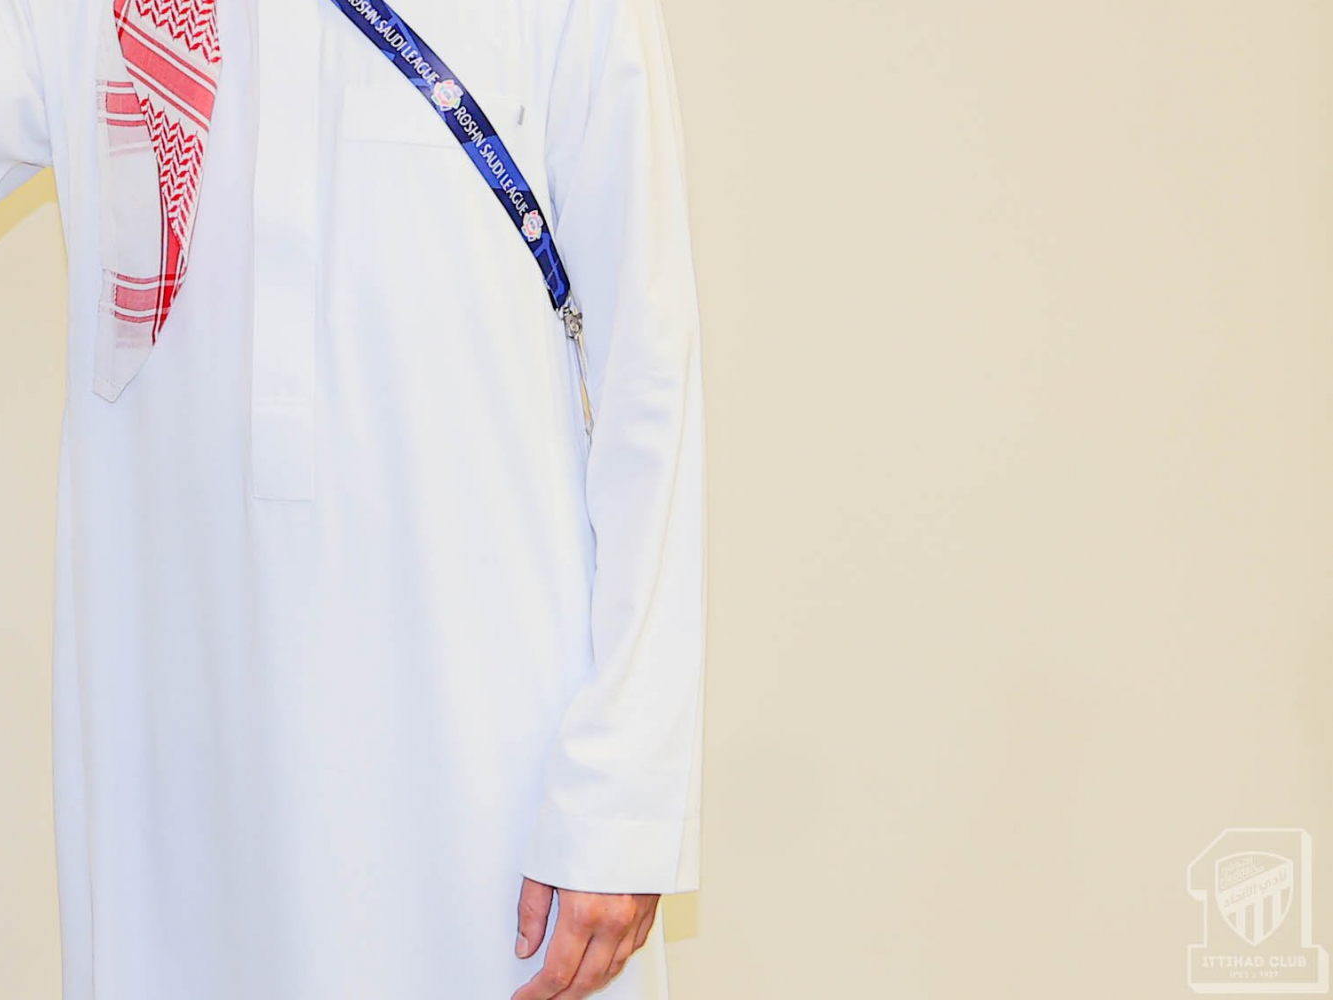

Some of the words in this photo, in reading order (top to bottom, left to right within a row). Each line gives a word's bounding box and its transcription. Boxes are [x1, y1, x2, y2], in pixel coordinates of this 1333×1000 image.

[375, 19, 408, 51] SAUDI
[400, 45, 440, 85] LEAGUE
[454, 106, 487, 147] ROSHN
[479, 143, 506, 179] SAUDI
[499, 173, 529, 216] LEAGUE
